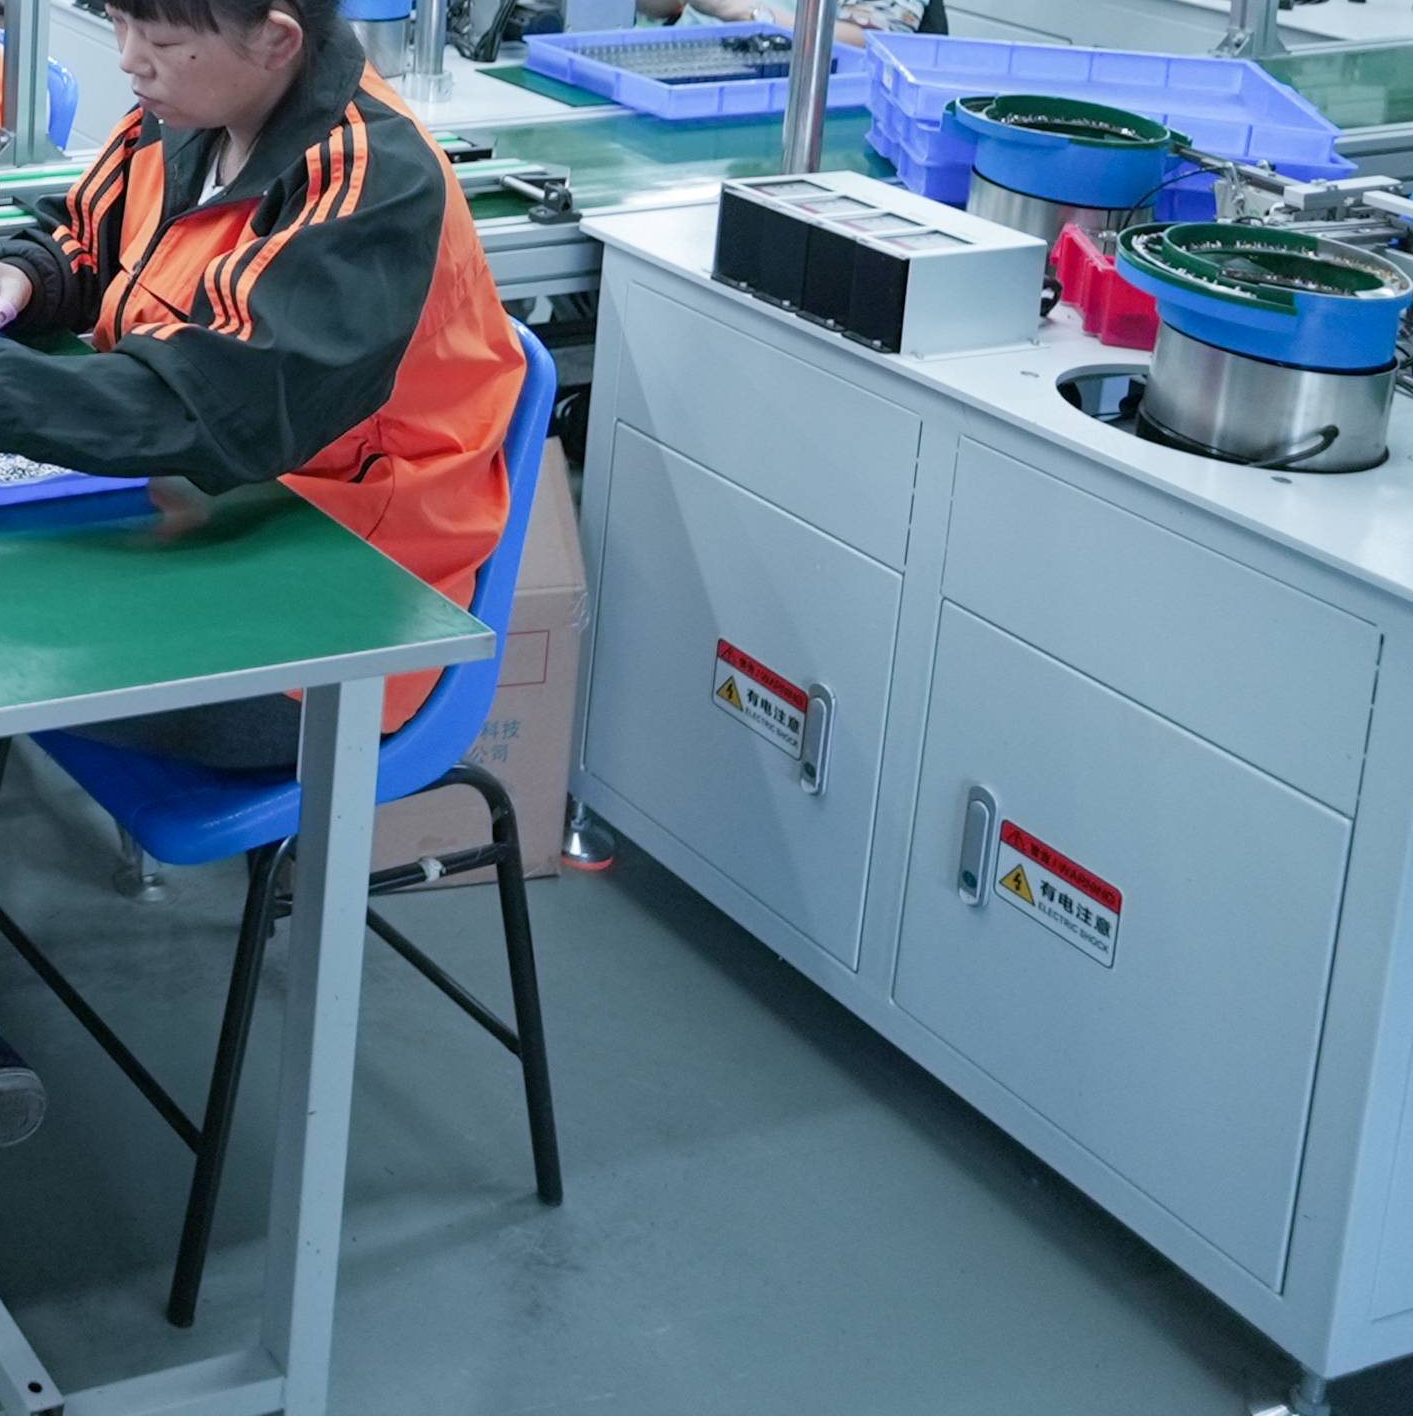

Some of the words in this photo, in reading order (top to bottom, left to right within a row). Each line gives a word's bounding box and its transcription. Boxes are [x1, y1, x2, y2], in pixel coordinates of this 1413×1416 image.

[747, 687, 800, 734] 有电注意
[1038, 901, 1078, 934] ELECTRIC
[1078, 927, 1109, 954] SHOCK
[1040, 879, 1112, 939] 有电注意
